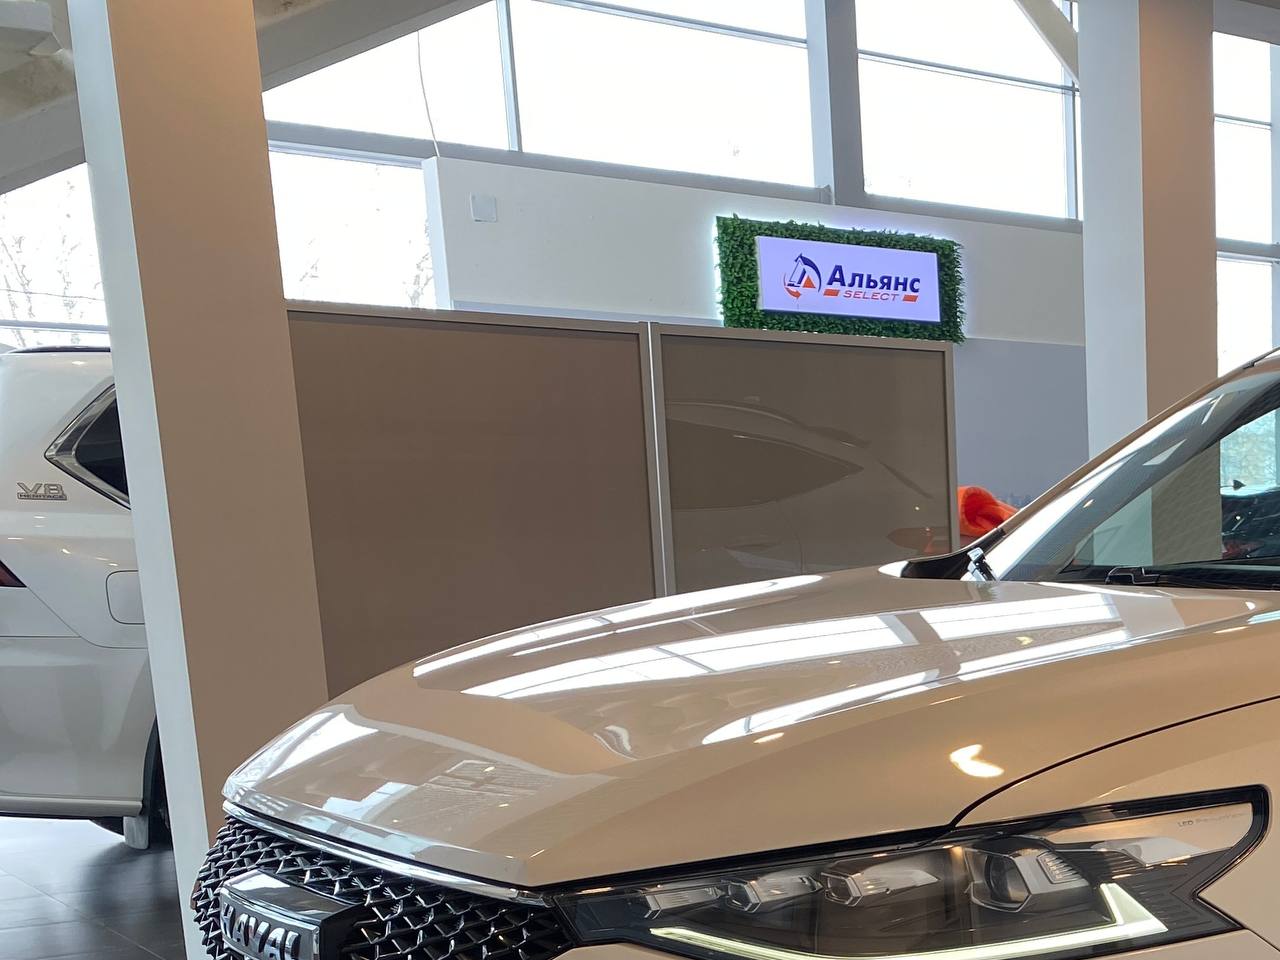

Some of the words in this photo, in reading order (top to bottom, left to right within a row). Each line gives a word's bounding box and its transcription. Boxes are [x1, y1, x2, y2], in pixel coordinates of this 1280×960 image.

[827, 264, 920, 293] Альянс
[843, 289, 899, 301] SELECT
[17, 482, 64, 495] V8
